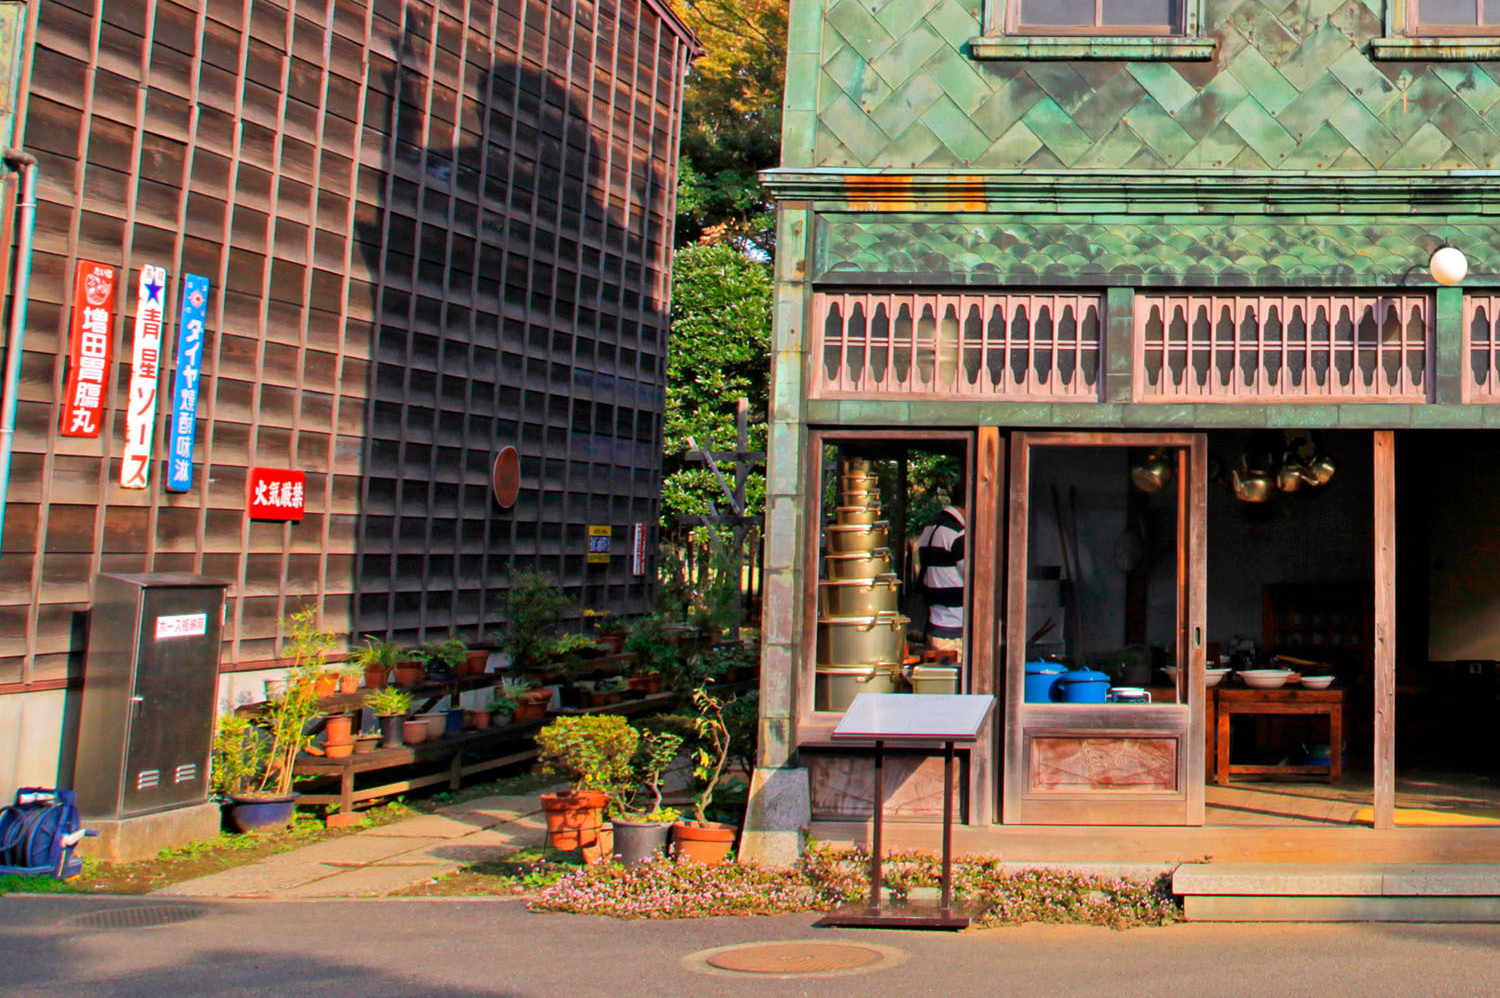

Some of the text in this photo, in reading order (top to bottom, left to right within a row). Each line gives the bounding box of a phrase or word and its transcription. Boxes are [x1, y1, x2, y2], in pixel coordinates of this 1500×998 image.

[127, 308, 162, 484] 青星ソース
[253, 479, 304, 509] 火気厳禁
